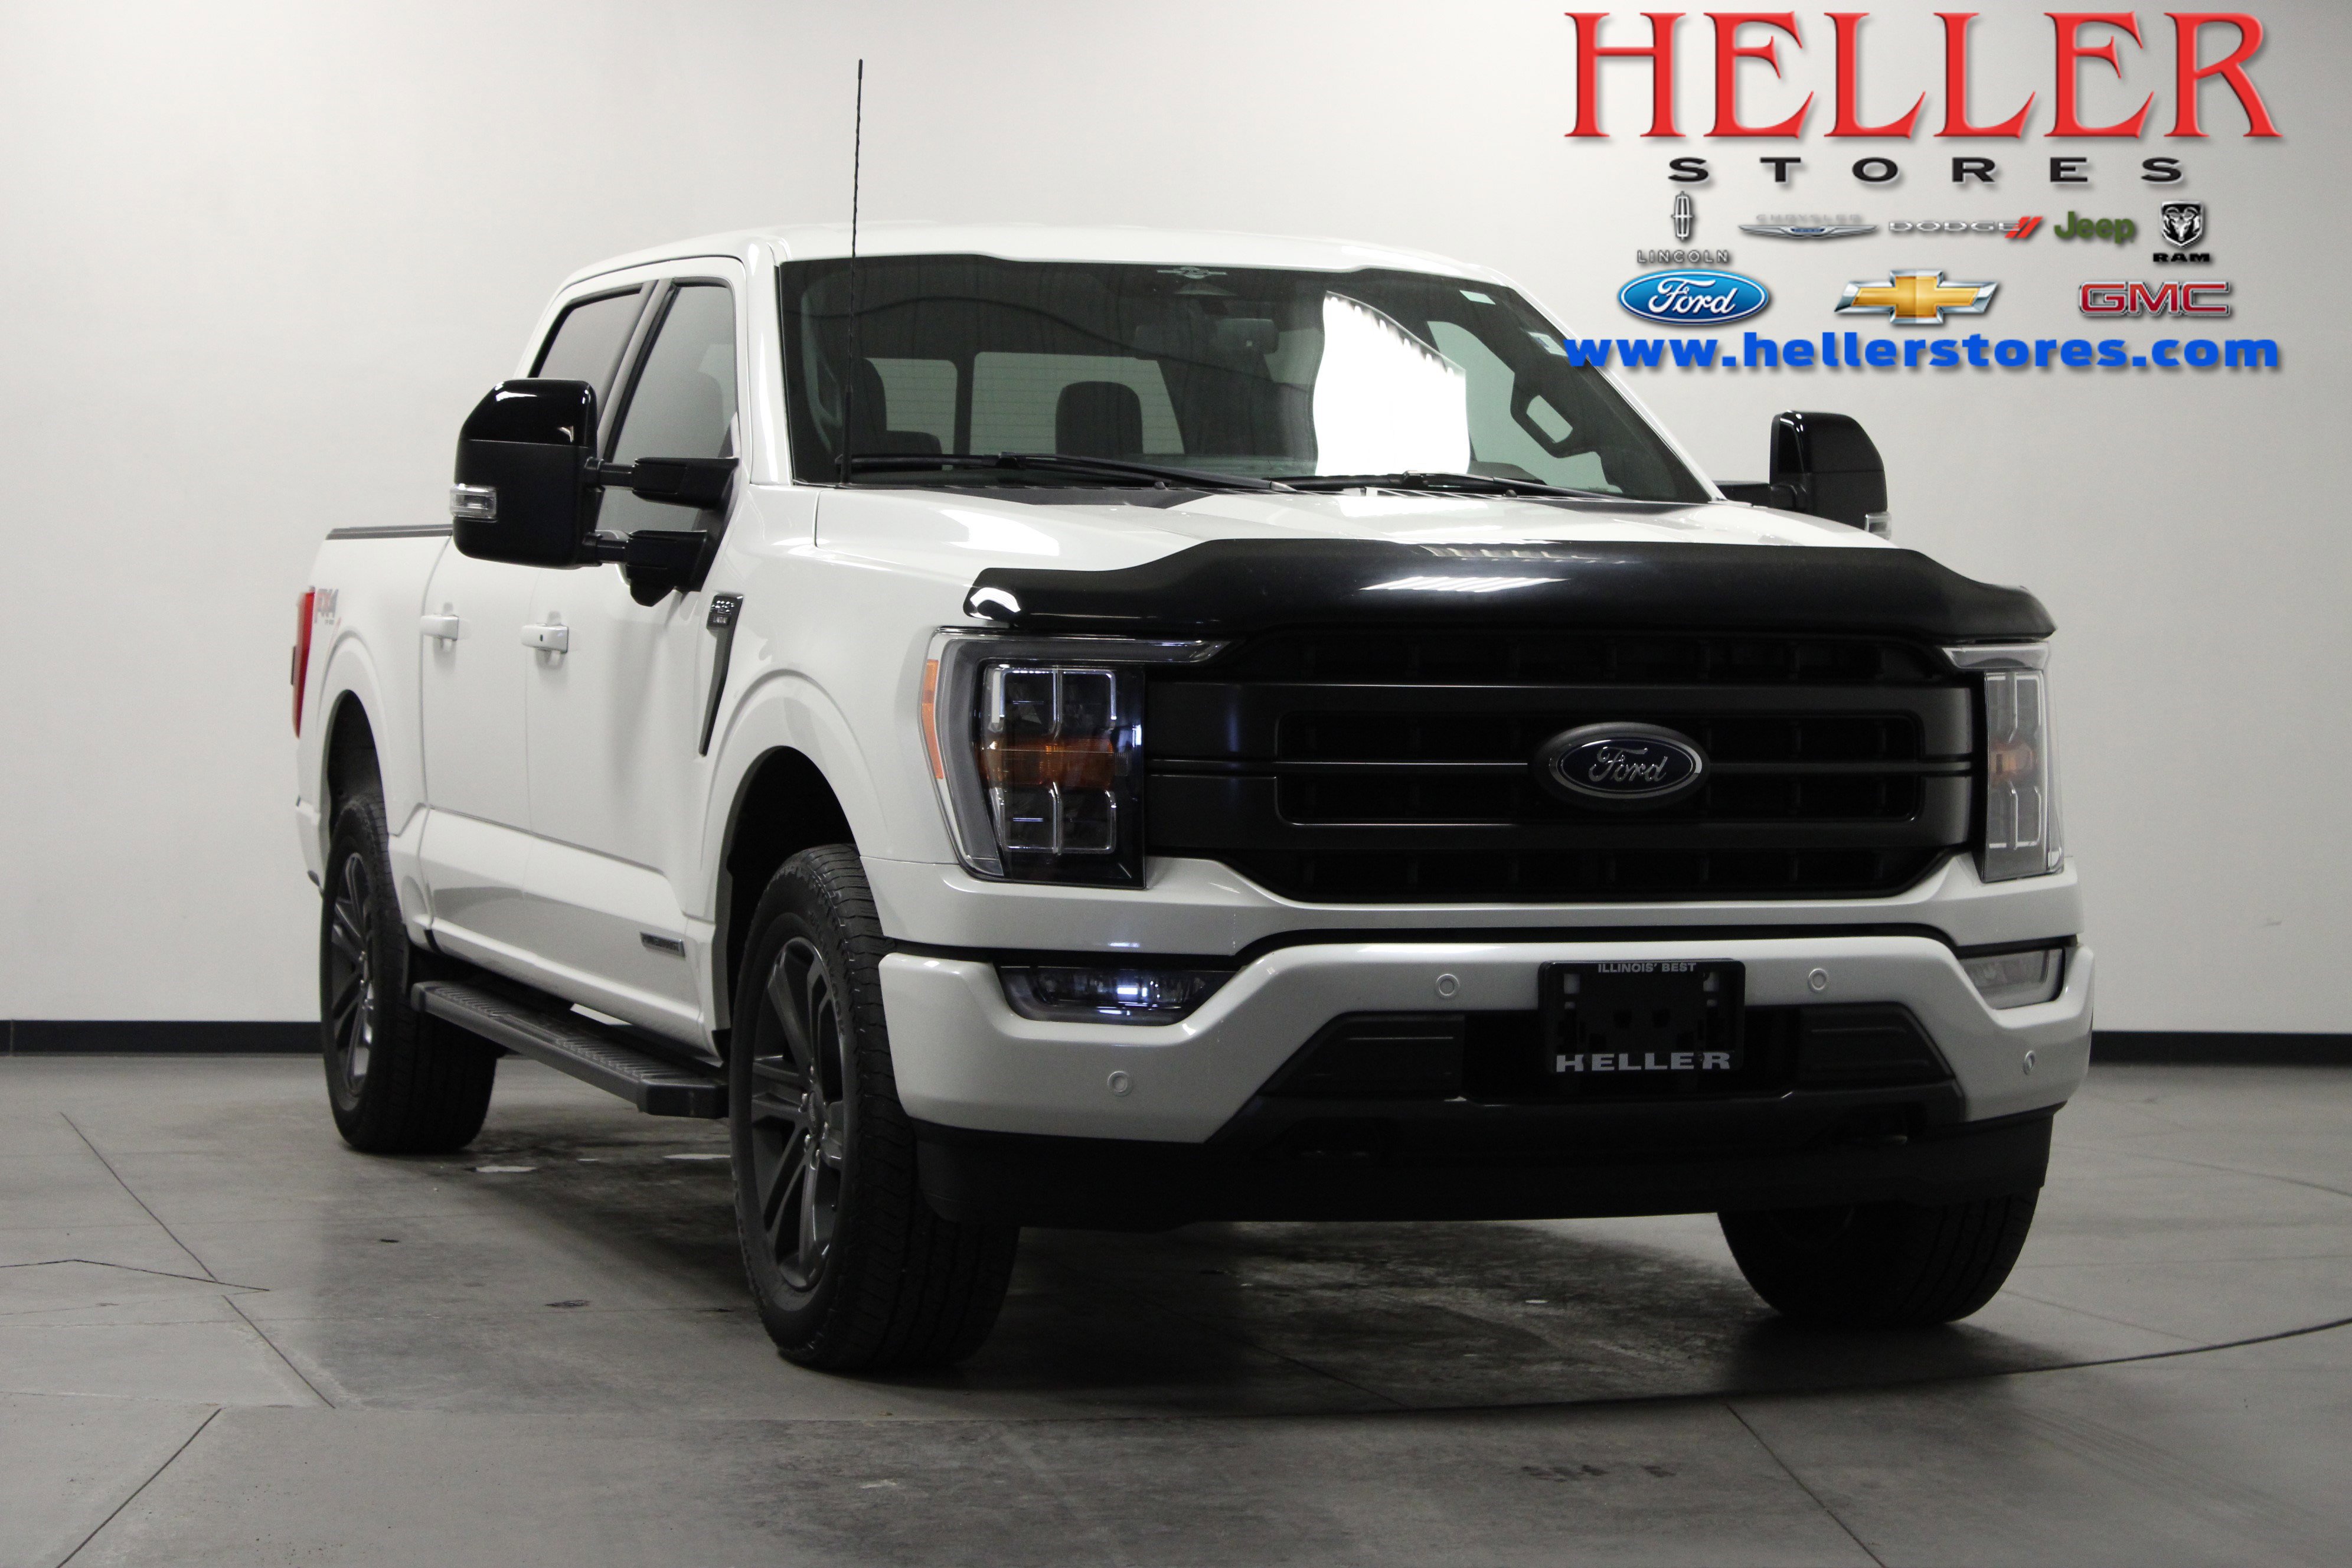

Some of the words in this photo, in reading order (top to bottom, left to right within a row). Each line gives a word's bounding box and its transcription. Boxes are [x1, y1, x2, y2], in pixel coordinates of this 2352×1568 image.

[1588, 746, 1668, 782] Ford
[1598, 963, 1657, 974] ILLINOIS'
[1661, 962, 1696, 972] BEST
[1556, 1052, 1730, 1073] HELLER
